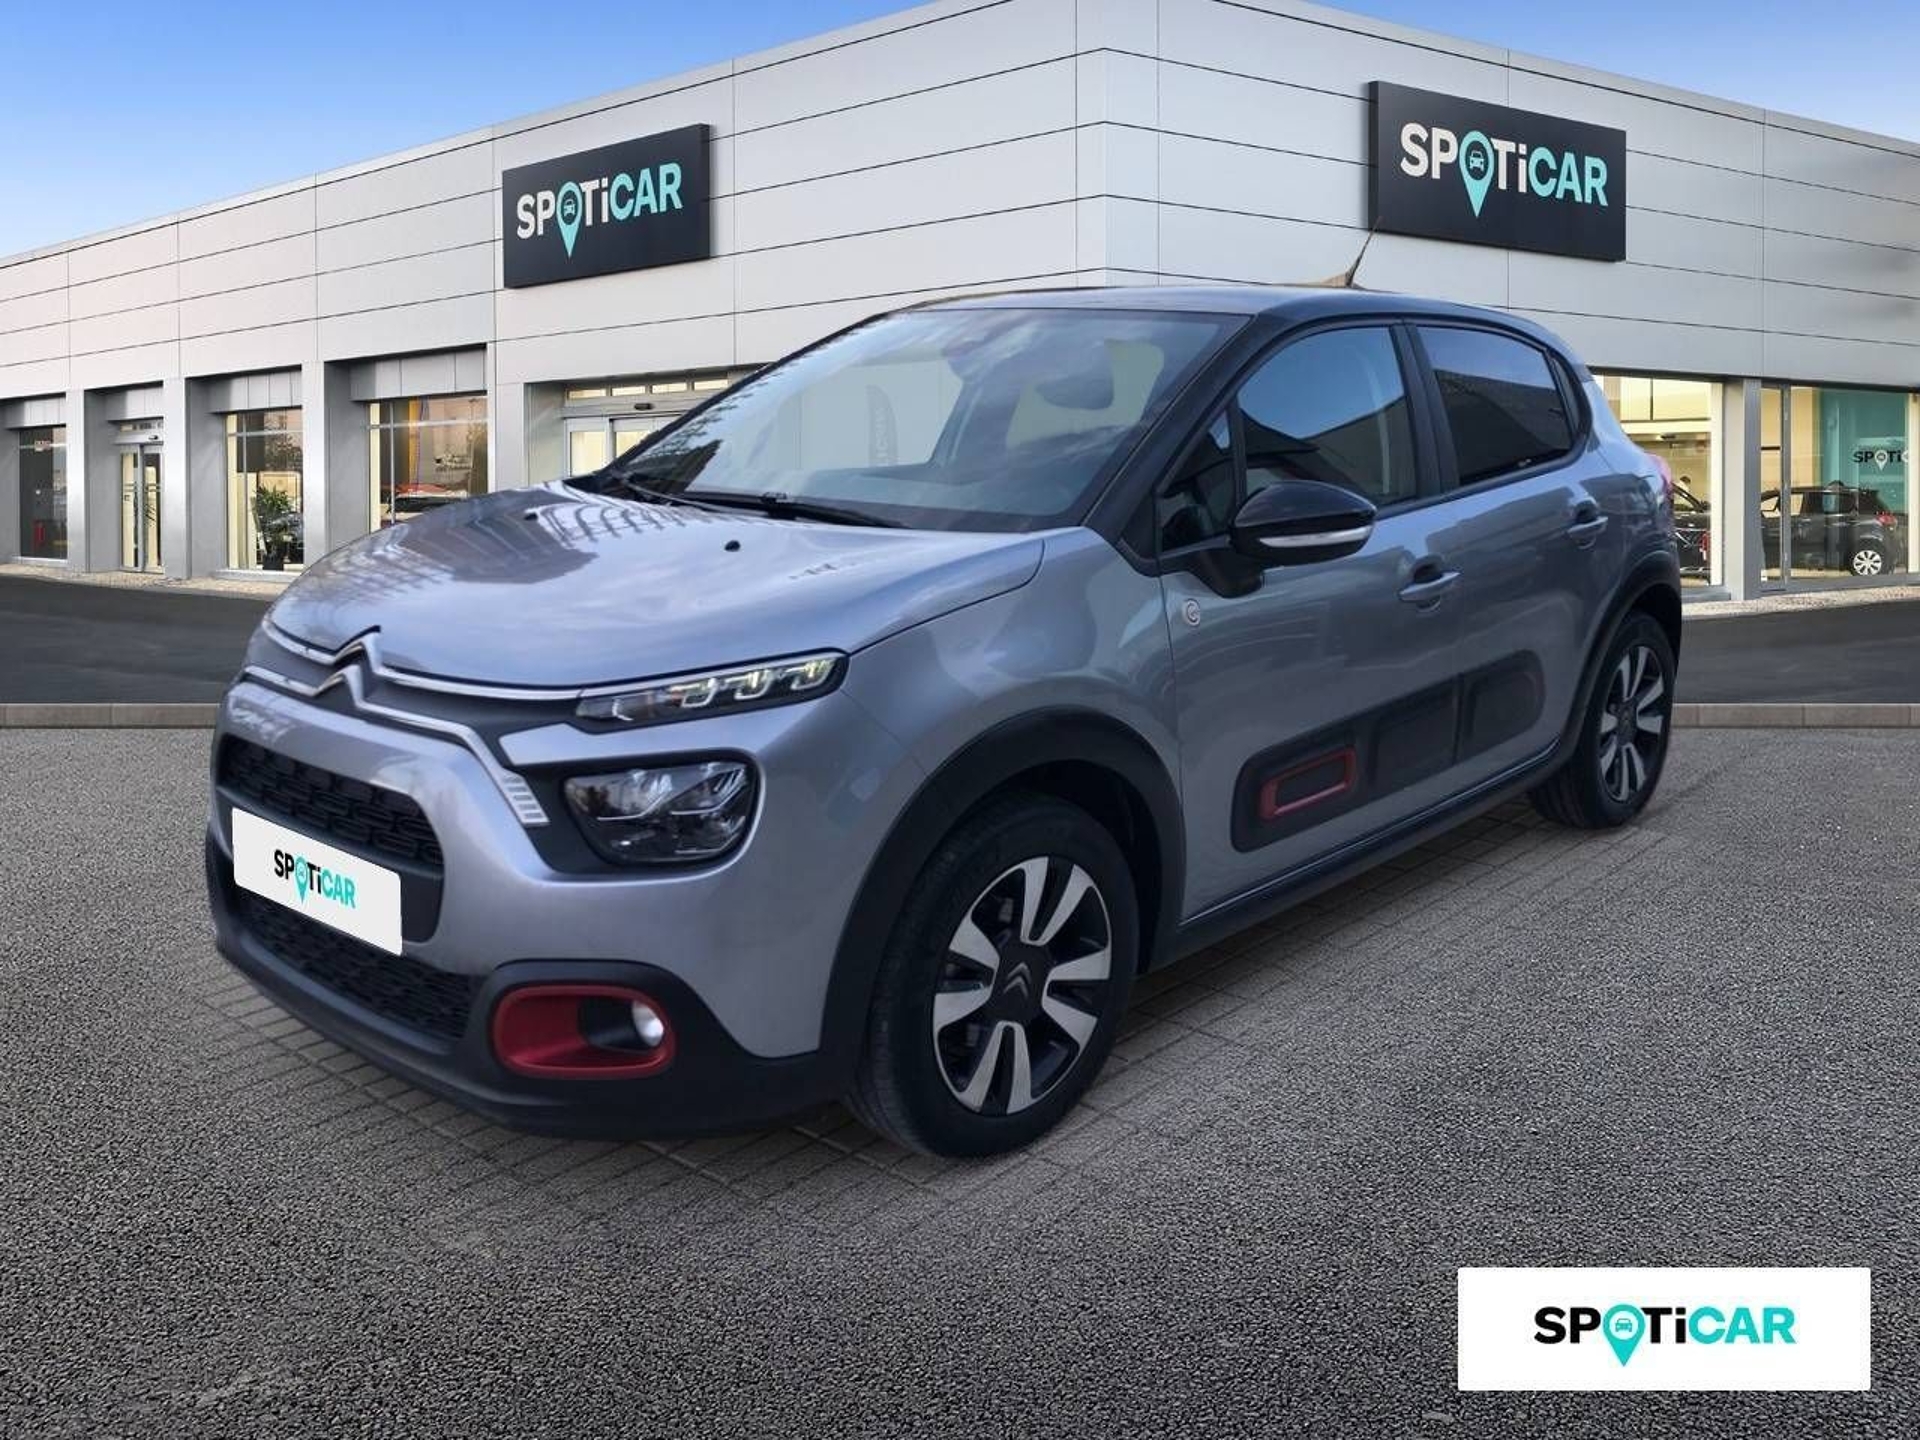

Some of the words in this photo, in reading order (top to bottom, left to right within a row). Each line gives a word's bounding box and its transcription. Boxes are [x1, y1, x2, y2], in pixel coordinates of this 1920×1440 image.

[516, 161, 683, 259] SPOTiCAR
[1400, 122, 1609, 218] SPOTiCAR
[274, 848, 356, 909] SPOTiCAR
